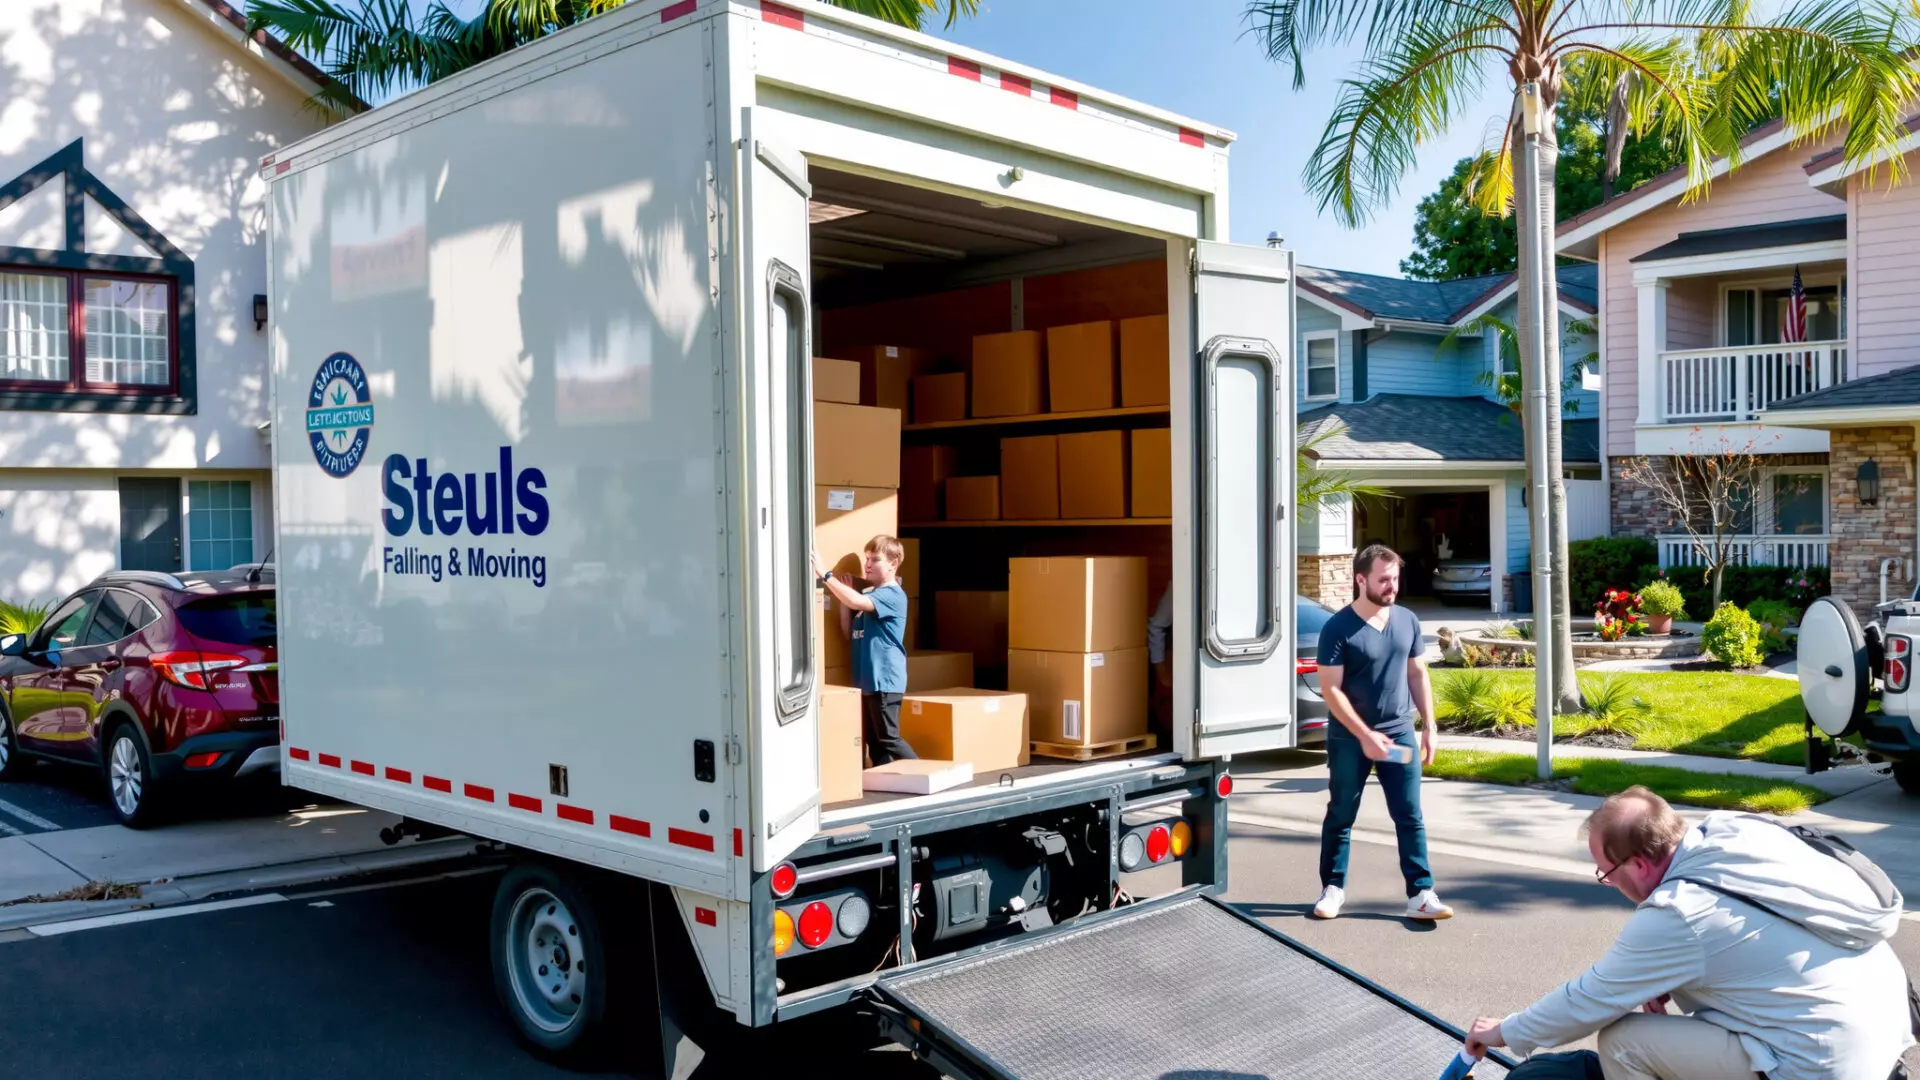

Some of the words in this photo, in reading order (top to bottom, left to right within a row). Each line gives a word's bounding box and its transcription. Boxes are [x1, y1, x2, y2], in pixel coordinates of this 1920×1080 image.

[381, 446, 550, 537] Steuls
[384, 547, 442, 583] Falling
[448, 547, 462, 576] &
[468, 547, 546, 588] Moving
